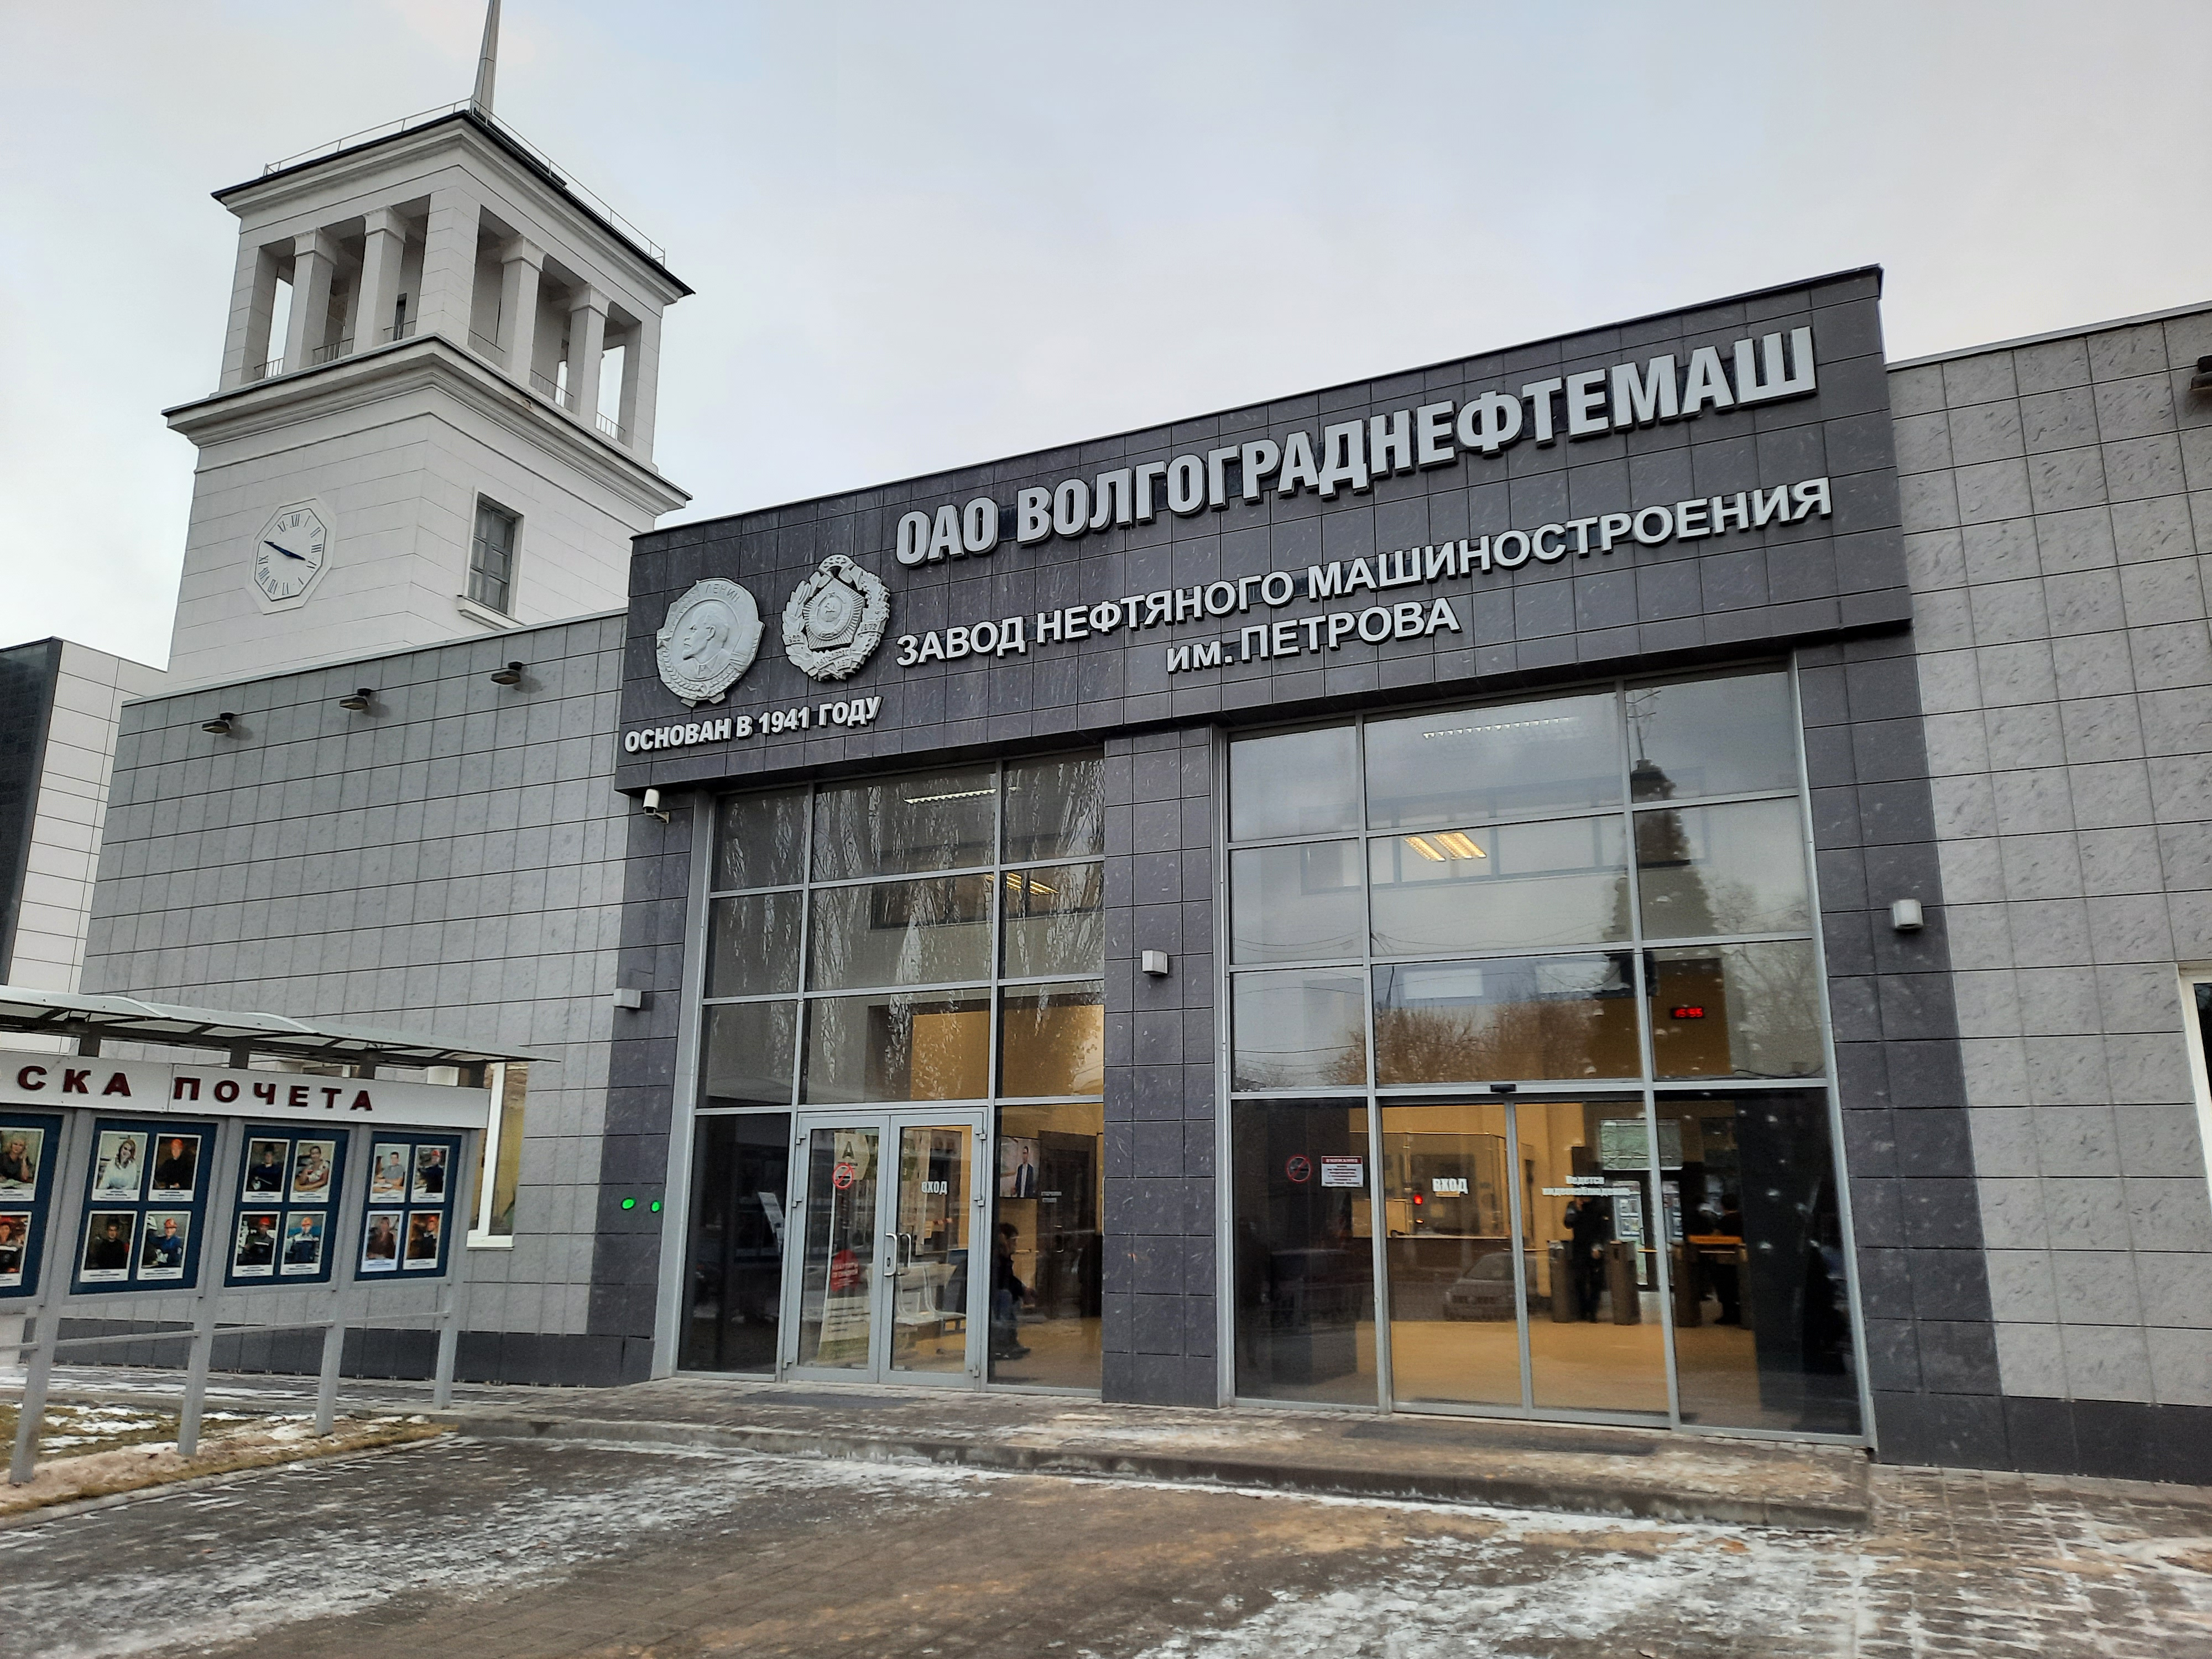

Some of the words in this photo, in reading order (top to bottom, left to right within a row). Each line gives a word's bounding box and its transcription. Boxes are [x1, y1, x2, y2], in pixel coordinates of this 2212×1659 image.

[896, 497, 998, 566] ОАО
[1017, 325, 1817, 547] ВОЛГОГРАДНЕФТЕМАШ
[706, 583, 740, 603] ЛЕНИН
[896, 616, 1027, 667] ЗАВОД
[1036, 571, 1293, 644] НЕФТЯНОГО
[1308, 477, 1832, 600] МАШИНОСТРОЕНИЯ
[1241, 596, 1462, 661] ПЕТРОВА
[624, 718, 732, 754] ОСНОВАН
[735, 715, 753, 739] В
[759, 706, 810, 735] 1941
[818, 695, 883, 728] ГОДУ
[173, 1076, 373, 1112] ПОЧЕТА
[1432, 1177, 1469, 1194] ВХОД
